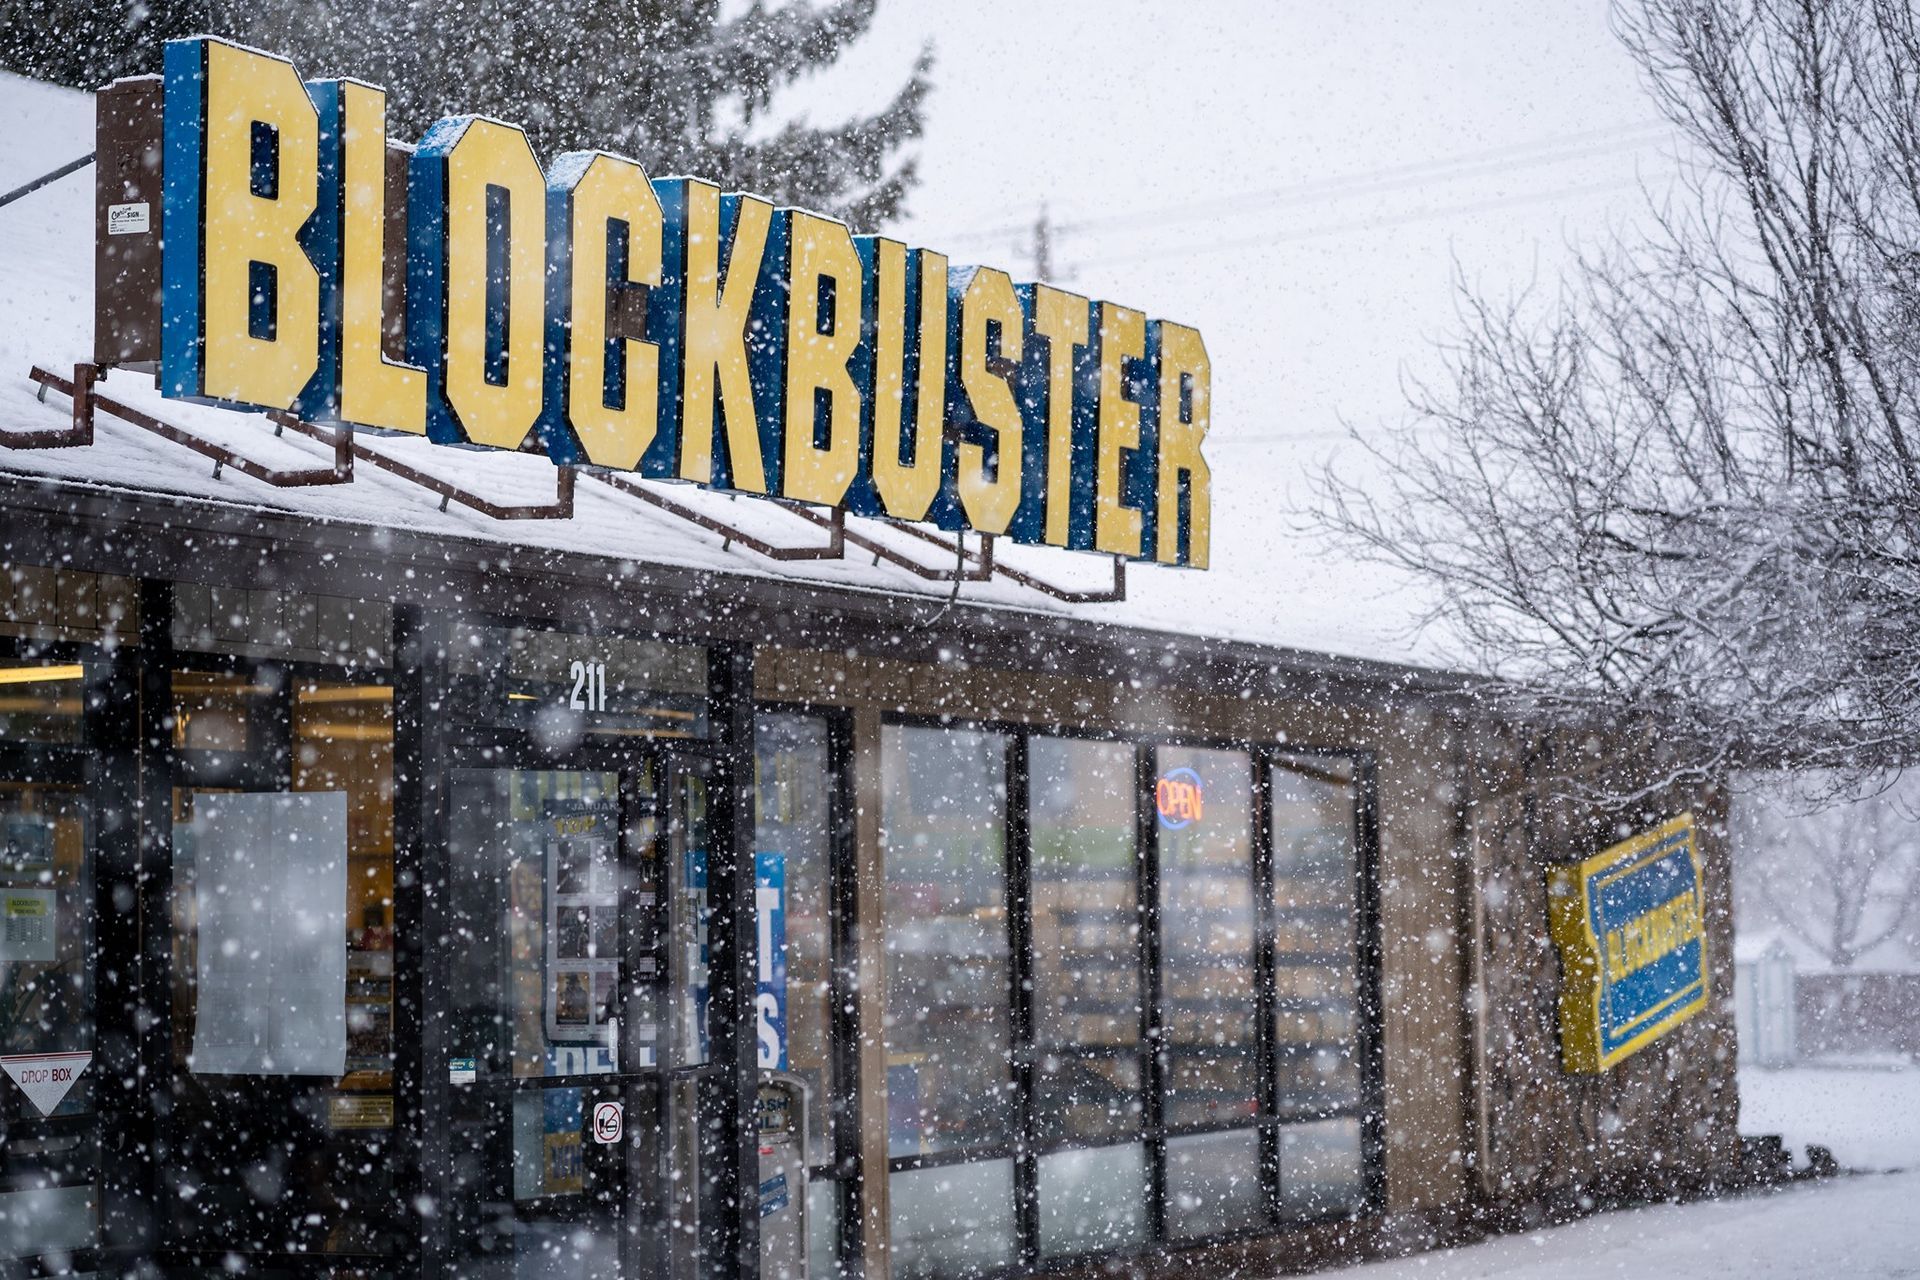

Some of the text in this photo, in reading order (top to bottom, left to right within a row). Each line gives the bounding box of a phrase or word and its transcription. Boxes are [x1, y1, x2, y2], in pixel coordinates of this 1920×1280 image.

[200, 37, 1211, 570] BLOCKBUSTER
[570, 660, 606, 712] 211
[571, 802, 619, 812] JANUAR
[1156, 779, 1202, 820] OPEN
[609, 1019, 617, 1060] PULL
[21, 1067, 72, 1083] DROP BOX
[757, 1095, 788, 1112] ASH
